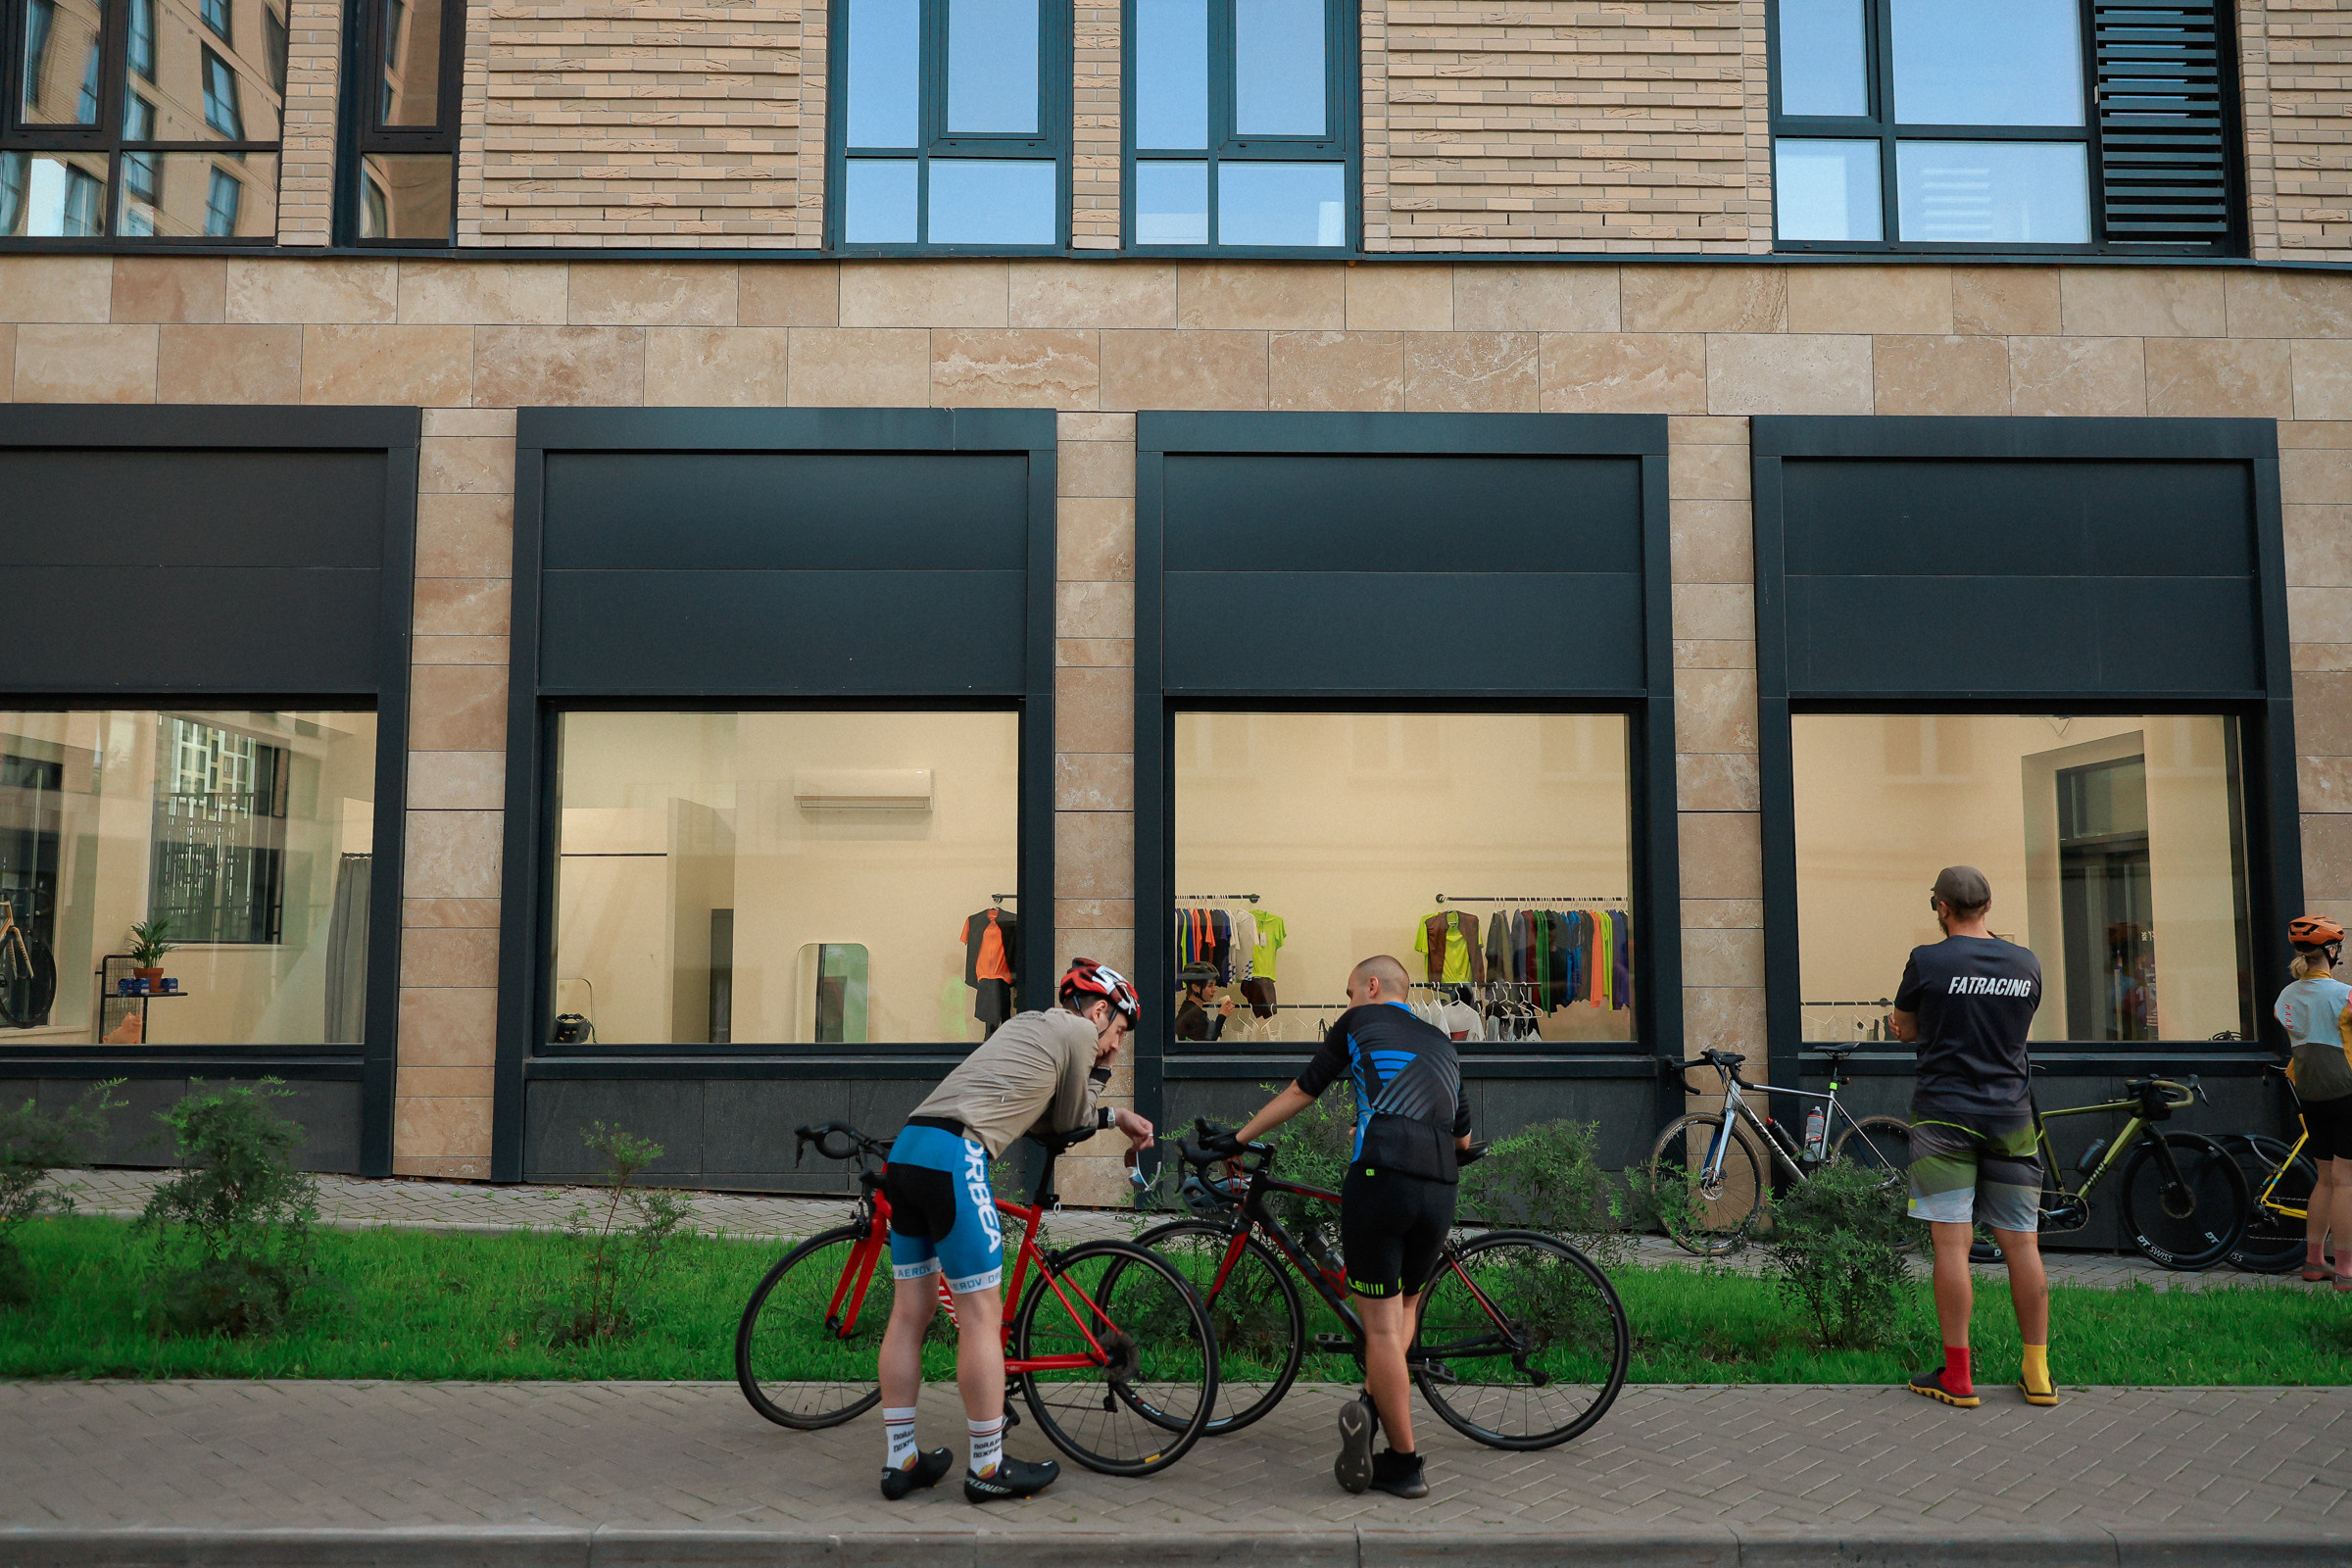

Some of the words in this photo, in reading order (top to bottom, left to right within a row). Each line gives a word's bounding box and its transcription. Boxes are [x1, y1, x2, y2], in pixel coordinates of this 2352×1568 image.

[1948, 976, 2032, 998] FATRACING
[964, 1139, 1002, 1253] ORBEA
[2204, 1231, 2220, 1244] DT
[2136, 1235, 2151, 1248] DT
[2148, 1246, 2174, 1263] SWISS
[2230, 1251, 2244, 1262] ISS
[951, 1277, 982, 1292] EROV
